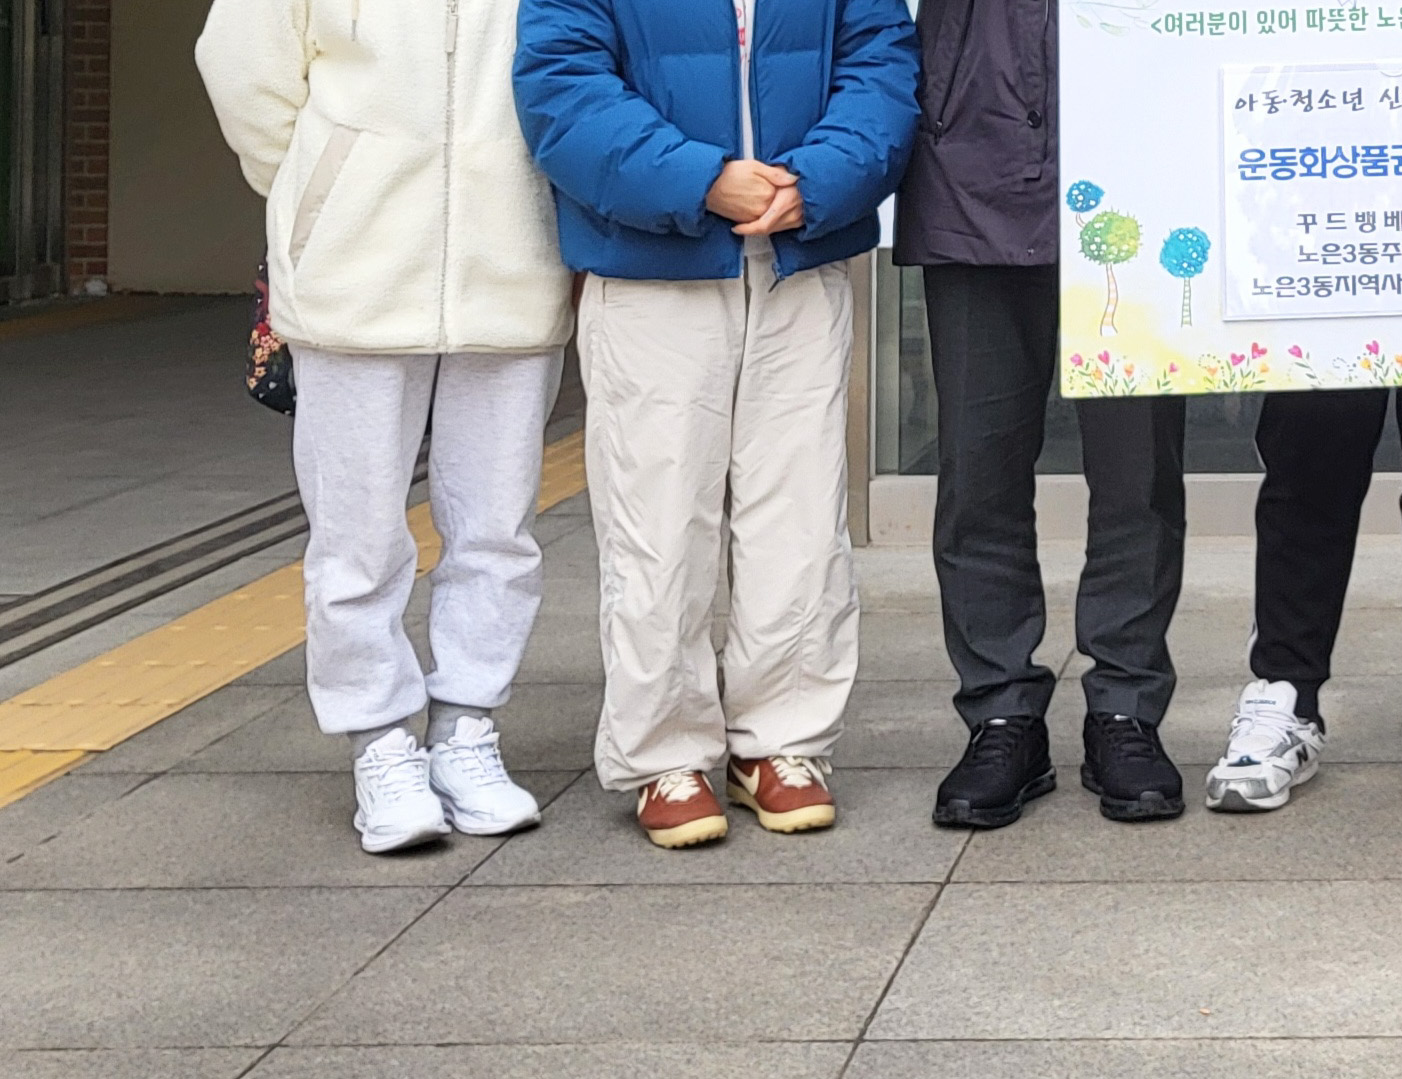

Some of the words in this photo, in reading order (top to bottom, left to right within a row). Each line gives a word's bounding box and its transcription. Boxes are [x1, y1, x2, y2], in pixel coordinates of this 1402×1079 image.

[1151, 11, 1248, 36] <여러분이
[1256, 9, 1298, 34] 있어
[1305, 6, 1369, 32] 따뜻한
